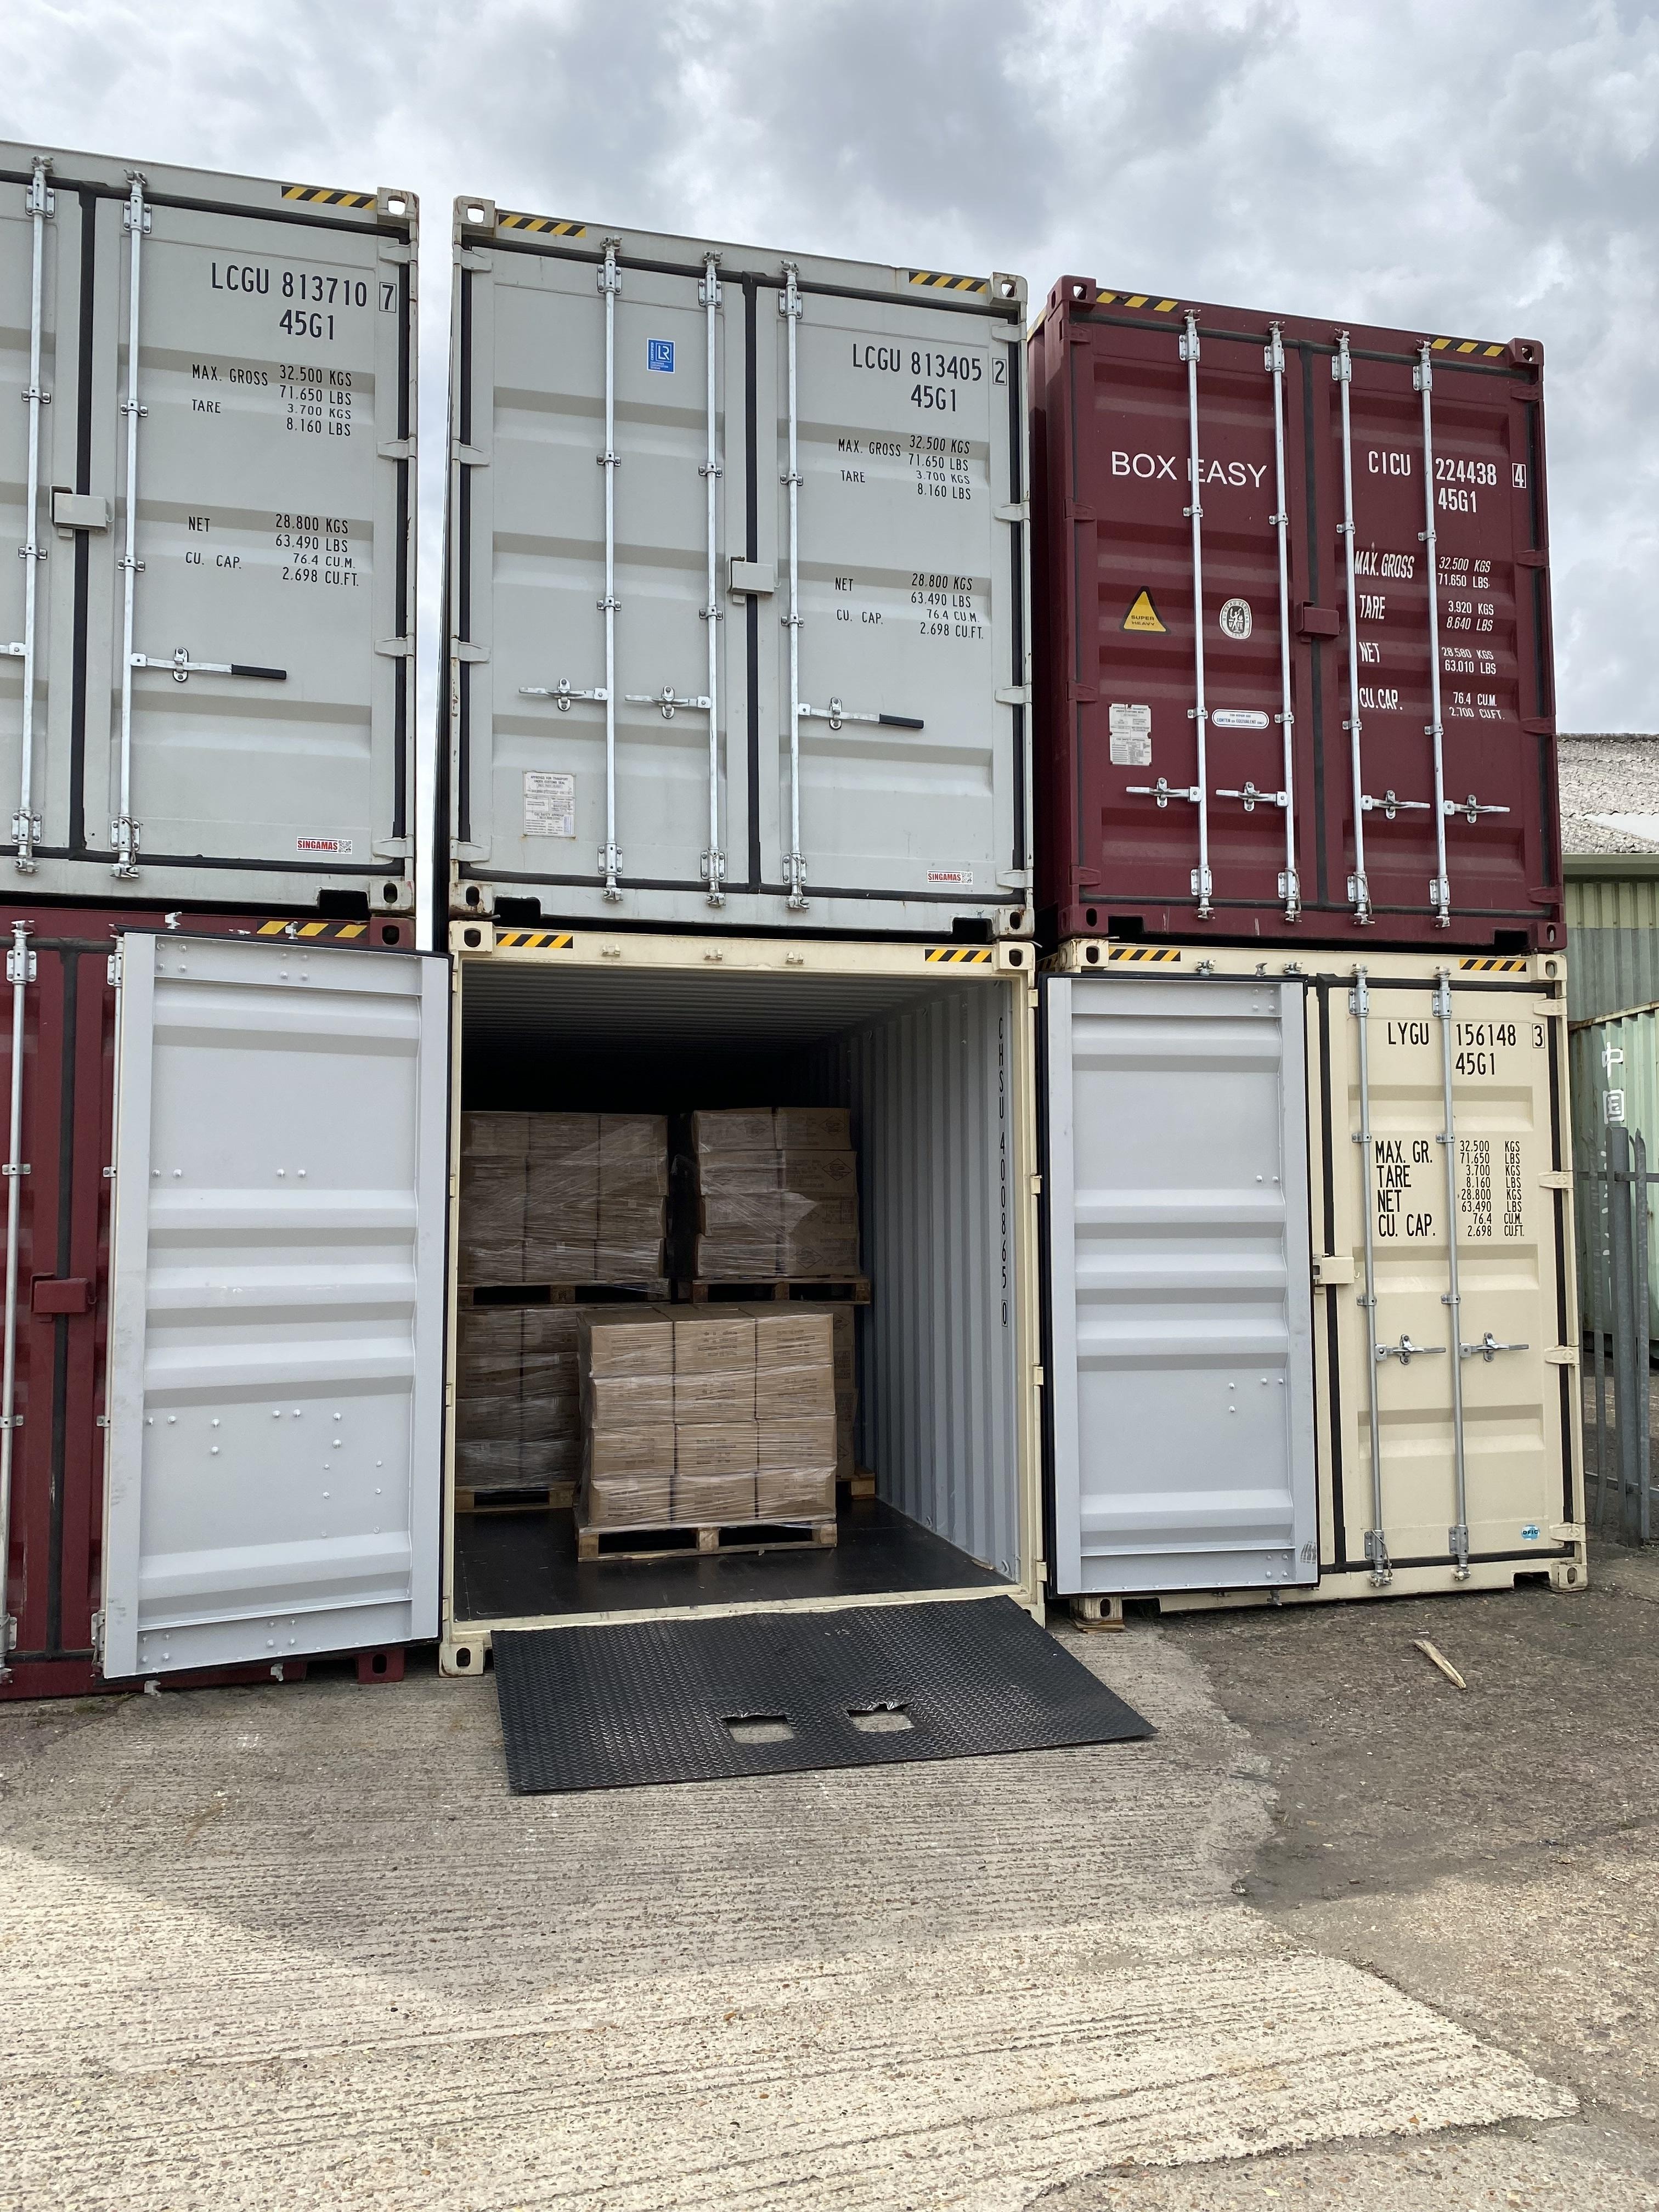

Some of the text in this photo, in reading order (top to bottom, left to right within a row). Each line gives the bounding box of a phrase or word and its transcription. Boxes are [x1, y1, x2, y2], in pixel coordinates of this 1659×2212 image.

[212, 262, 394, 310] LCGU 813710 7
[279, 309, 334, 340] 45G1
[658, 345, 670, 360] LR
[853, 343, 1005, 383] LCGU 813405 2
[192, 364, 222, 381] MAX.
[230, 368, 268, 386] GROSS
[330, 370, 352, 387] KGS
[330, 391, 352, 405] LBS
[911, 384, 956, 411] 45G1
[192, 399, 221, 414] TARE
[329, 408, 351, 420] KGS
[329, 421, 351, 436] LBS
[838, 438, 863, 454] MAX.
[869, 442, 901, 456] GROSS
[951, 439, 970, 454] KGS
[950, 458, 968, 471] LBS
[1111, 451, 1267, 488] BOX EASY
[1368, 450, 1524, 487] CICU 224438 4
[840, 470, 866, 483] TARE
[951, 473, 970, 484] KGS
[952, 486, 971, 500] LBS
[1438, 487, 1477, 513] 45G1
[189, 516, 210, 532] NET
[326, 518, 348, 534] KGS
[326, 538, 348, 552] LBS
[186, 552, 356, 569] CU. CAP. 76.4 CU.M.
[1354, 551, 1379, 576] MAX.
[1381, 553, 1414, 579] GROSS
[1474, 560, 1491, 573] KGS
[325, 571, 359, 586] CU.FT.
[835, 577, 853, 591] NET
[953, 577, 973, 591] KGS
[952, 595, 970, 608] LBS
[1359, 595, 1385, 619] TARE
[1478, 603, 1494, 616] KGS
[837, 609, 852, 622] CU.
[862, 611, 883, 624] CAP.
[927, 608, 949, 620] 76.4
[1223, 602, 1249, 623] BUREAU VERITAS
[955, 625, 984, 639] CU.FT.
[1476, 619, 1493, 632] LBS
[1358, 641, 1380, 663] NET
[1476, 650, 1494, 660] KGS
[1481, 663, 1496, 675] LBS
[1359, 687, 1403, 710] CU.CAP.
[1453, 692, 1471, 705] 76.4
[297, 840, 338, 850] SINGAMAS
[928, 873, 961, 881] SINGAMAS
[1387, 1022, 1543, 1047] LYGU 156148 3
[1455, 1052, 1495, 1075] 45G1
[1375, 1140, 1406, 1164] MAX.
[1413, 1140, 1432, 1163] GR.
[1504, 1141, 1520, 1152] KGS
[1505, 1153, 1520, 1164] LBS
[1376, 1165, 1412, 1188] TARE
[1505, 1165, 1521, 1176] KGS
[1506, 1177, 1521, 1188] LBS
[1378, 1189, 1402, 1212] NET
[1506, 1189, 1522, 1200] KGS
[1507, 1201, 1522, 1212] LBS
[1378, 1212, 1522, 1237] CU. CAP. 76.4 CU.M.
[1504, 1225, 1525, 1237] CU.FT.
